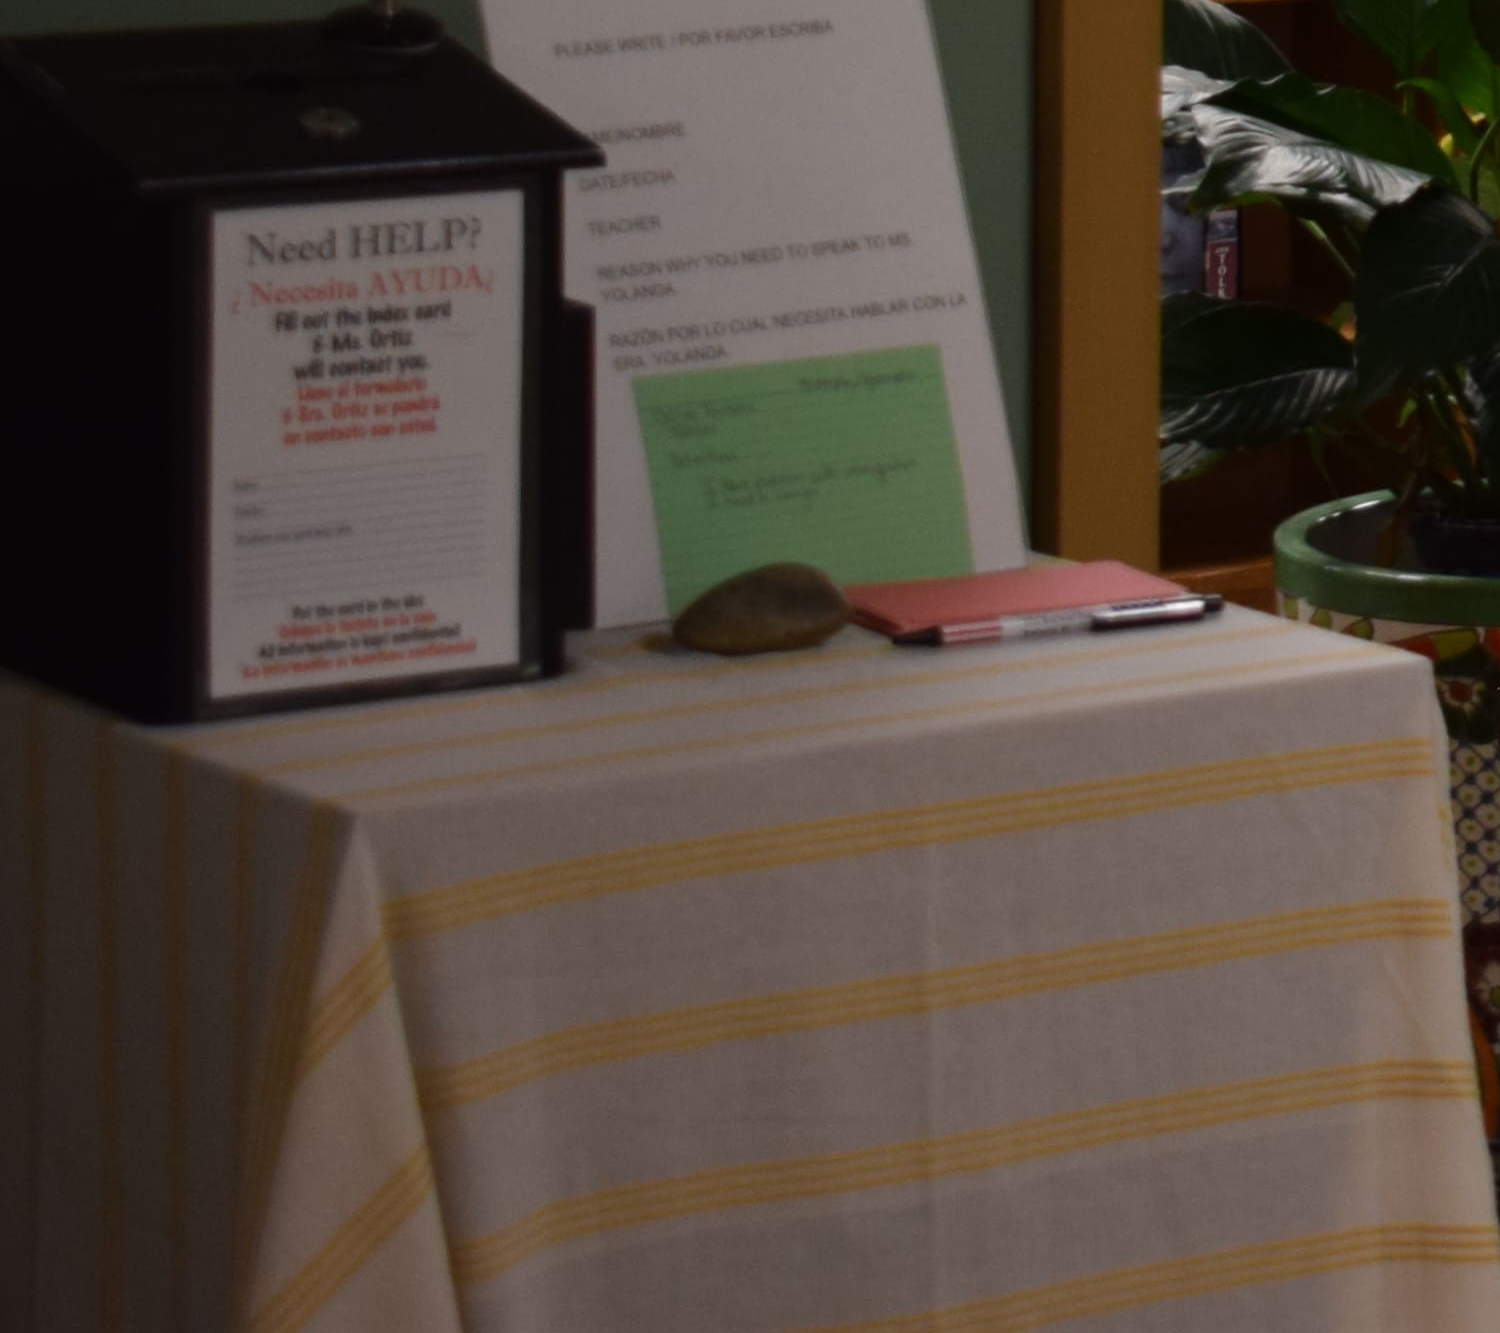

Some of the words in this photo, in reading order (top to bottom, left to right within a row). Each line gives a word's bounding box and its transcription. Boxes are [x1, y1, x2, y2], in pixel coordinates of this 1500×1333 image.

[554, 41, 613, 59] PLEASE
[617, 34, 666, 52] WRITE
[678, 28, 712, 47] POR
[714, 23, 765, 43] FAVOR
[766, 18, 834, 39] ESCRIBA
[578, 169, 676, 192] DATE/FECHA
[587, 214, 662, 235] TEACHER
[246, 228, 337, 265] Need
[349, 216, 482, 259] HELP?
[598, 260, 662, 281] REASON
[664, 256, 701, 274] WHY
[704, 251, 740, 269] YOU
[741, 247, 784, 265] NEED
[786, 244, 810, 260] TO
[811, 239, 861, 257] SPEAK
[864, 235, 886, 250] TO
[601, 282, 676, 303] YOLANDA
[274, 309, 299, 333] Fill
[302, 312, 329, 331] out
[335, 307, 362, 327] the
[414, 298, 453, 321] card
[666, 324, 701, 342] POR
[704, 321, 724, 338] LO
[727, 317, 768, 335] CUAL
[772, 307, 849, 329] NECESITA
[850, 298, 909, 319] HABLAR
[912, 294, 946, 312] CON
[949, 290, 968, 307] LA
[292, 356, 324, 381] will
[329, 355, 392, 378] contact
[654, 344, 728, 367] YOLANDA
